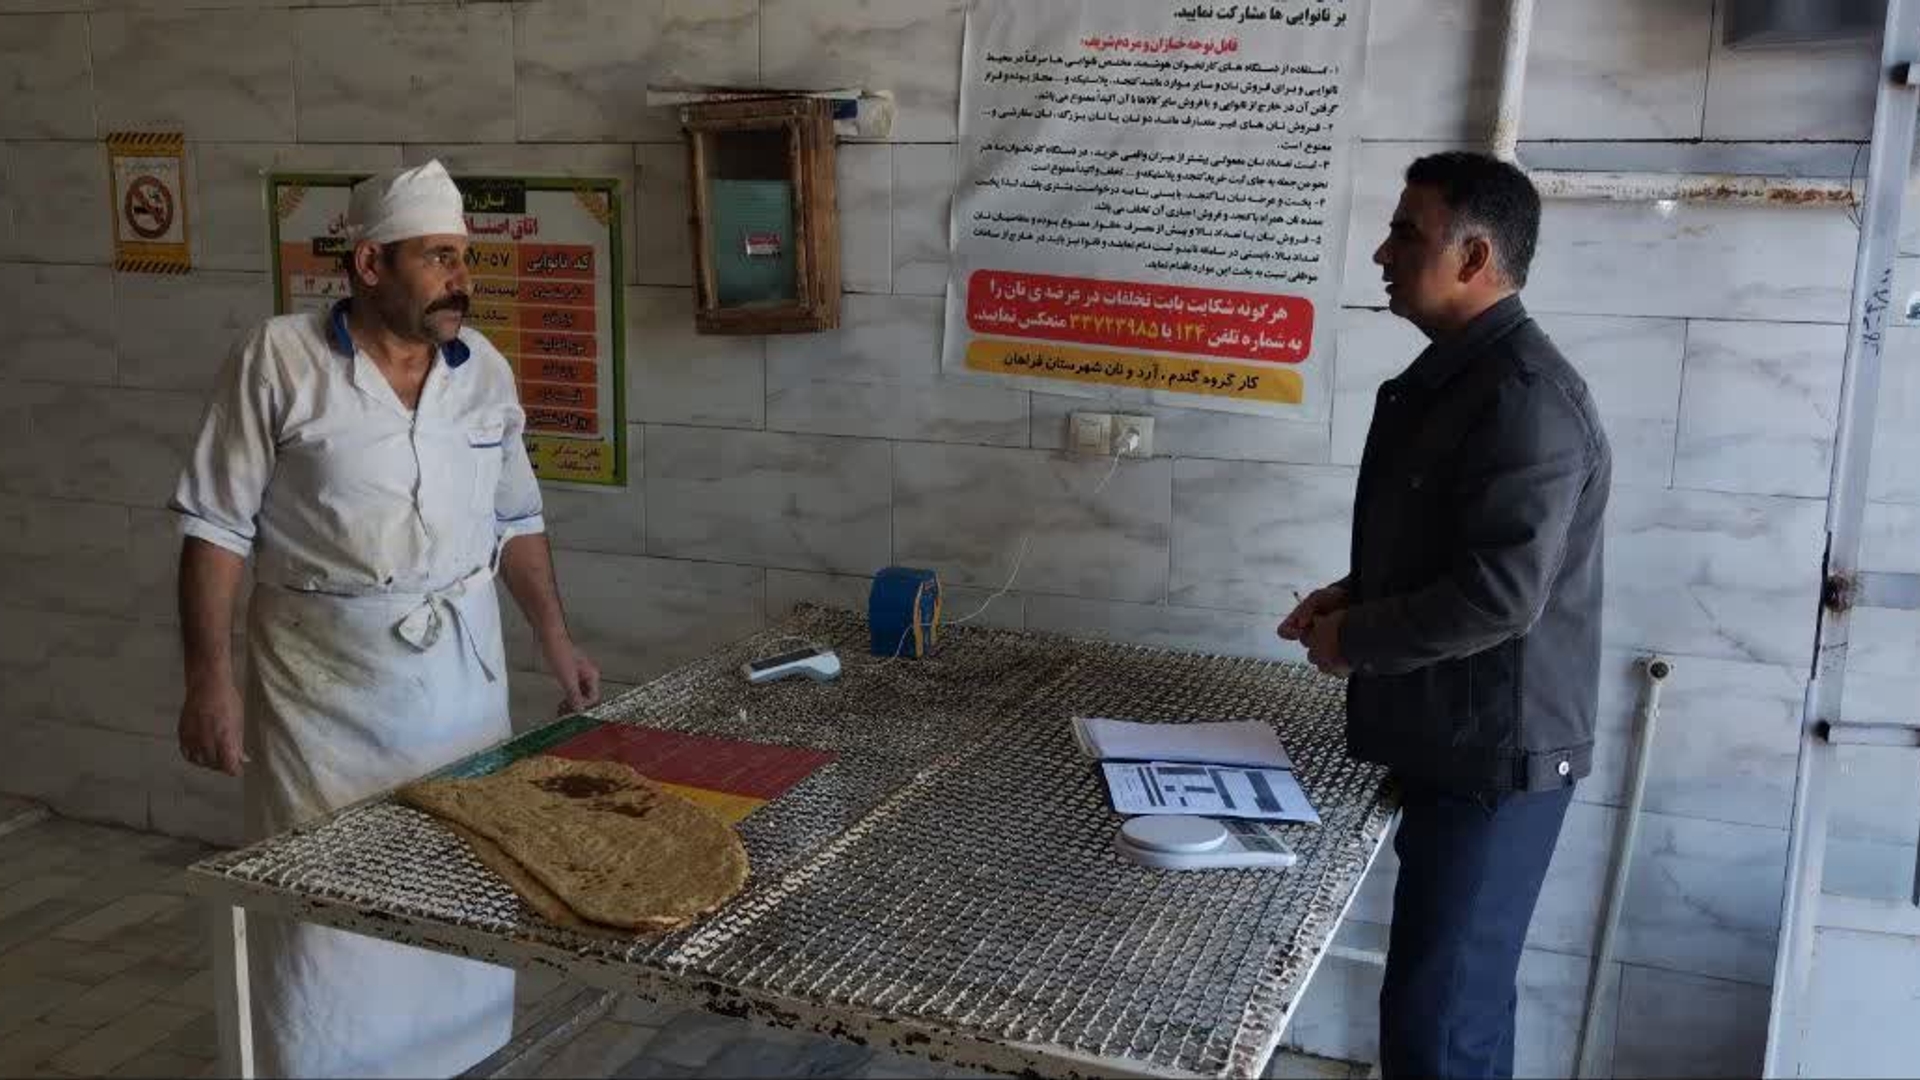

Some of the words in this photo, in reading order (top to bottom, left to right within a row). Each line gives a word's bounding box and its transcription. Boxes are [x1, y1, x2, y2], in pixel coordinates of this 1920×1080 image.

[1174, 5, 1213, 22] نمایید.
[1217, 5, 1266, 23] مشارکت
[1270, 6, 1283, 20] ها
[1286, 7, 1331, 25] نانوایی
[1333, 12, 1346, 27] بر
[1141, 42, 1150, 53] و
[1186, 40, 1214, 55] توجه
[1214, 38, 1238, 55] قابل
[1303, 142, 1332, 154] ممنوع
[990, 276, 1002, 300] را
[1004, 280, 1027, 301] نان
[1028, 284, 1042, 303] ی
[1043, 282, 1081, 306] عرضه
[1082, 289, 1100, 308] در
[1103, 289, 1152, 308] تخلفات
[1153, 293, 1185, 315] بابت
[1186, 296, 1235, 318] شکایت
[1017, 311, 1068, 329] منعکس
[1236, 301, 1269, 323] گونه
[1266, 306, 1288, 325] هر
[1160, 321, 1172, 342] یا
[1207, 327, 1241, 348] تلفن
[1241, 330, 1286, 353] شماره
[1287, 336, 1303, 355] به
[1004, 352, 1043, 370] فراهان
[1045, 357, 1102, 375] شهرستان
[1104, 362, 1124, 377] نان
[1138, 364, 1160, 381] آرد
[1168, 369, 1200, 387] گندم
[1202, 373, 1236, 390] گروه
[1237, 375, 1259, 391] کار
